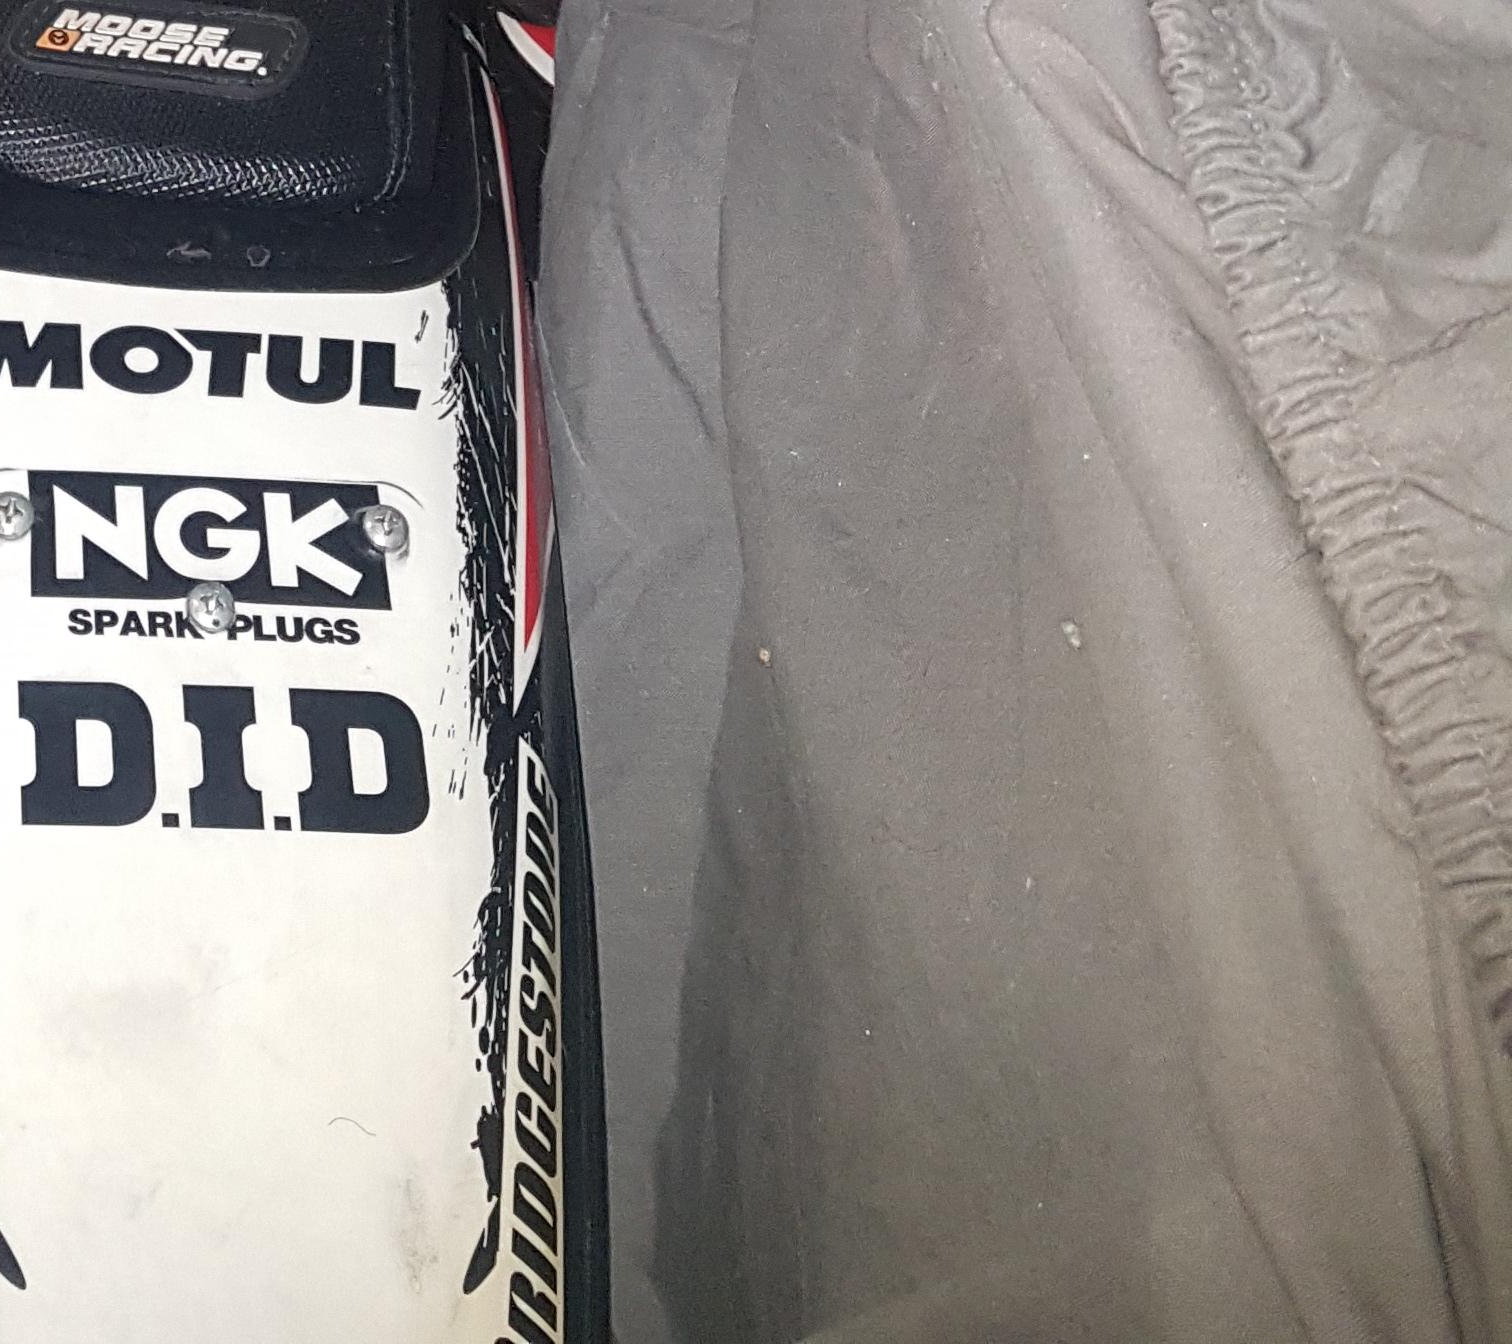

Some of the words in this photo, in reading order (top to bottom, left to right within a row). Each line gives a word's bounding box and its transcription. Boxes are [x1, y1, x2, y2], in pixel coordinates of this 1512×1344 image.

[53, 9, 231, 48] MOOSE
[52, 484, 364, 597] NGK
[68, 609, 205, 640] SPARK
[226, 613, 361, 645] PLUGS
[18, 680, 430, 835] D.I.D
[494, 756, 558, 1344] RIDGESTONE
